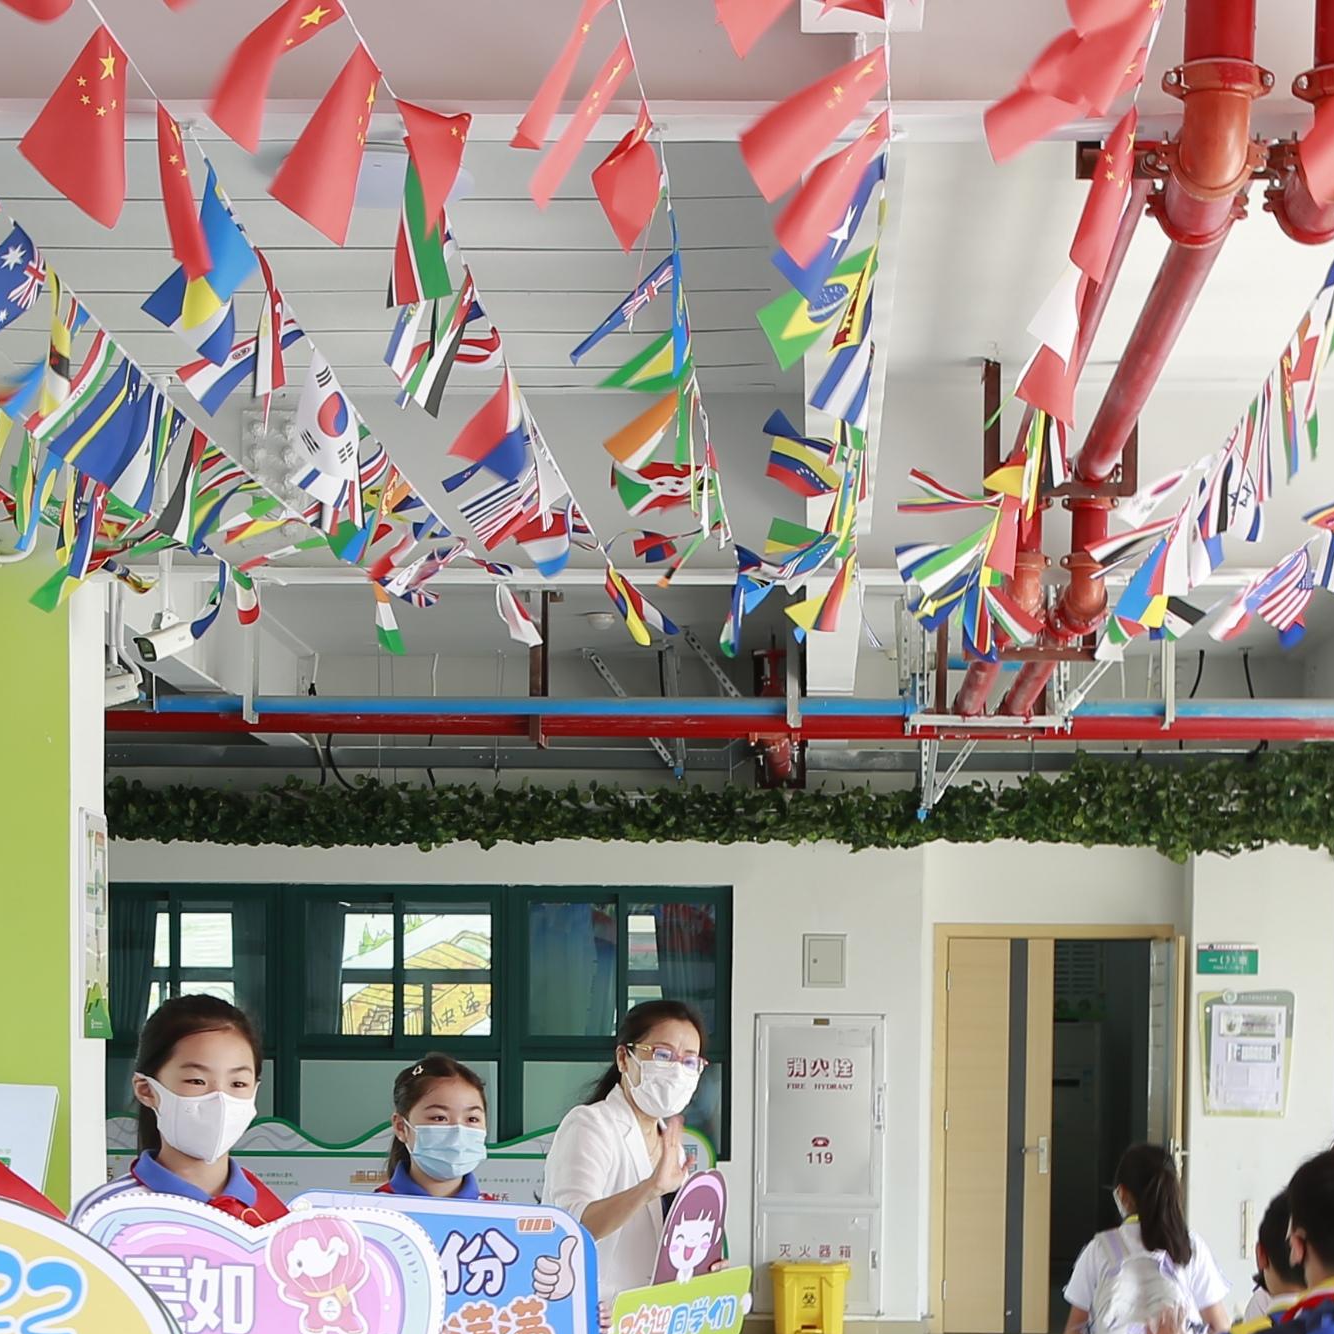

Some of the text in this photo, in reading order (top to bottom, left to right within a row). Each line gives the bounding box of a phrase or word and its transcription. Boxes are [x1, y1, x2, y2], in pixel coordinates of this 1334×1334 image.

[787, 1057, 853, 1078] 消火栓
[814, 1083, 853, 1091] HYDRANT
[806, 1152, 833, 1164] 119
[779, 1243, 851, 1258] 灭火器箱
